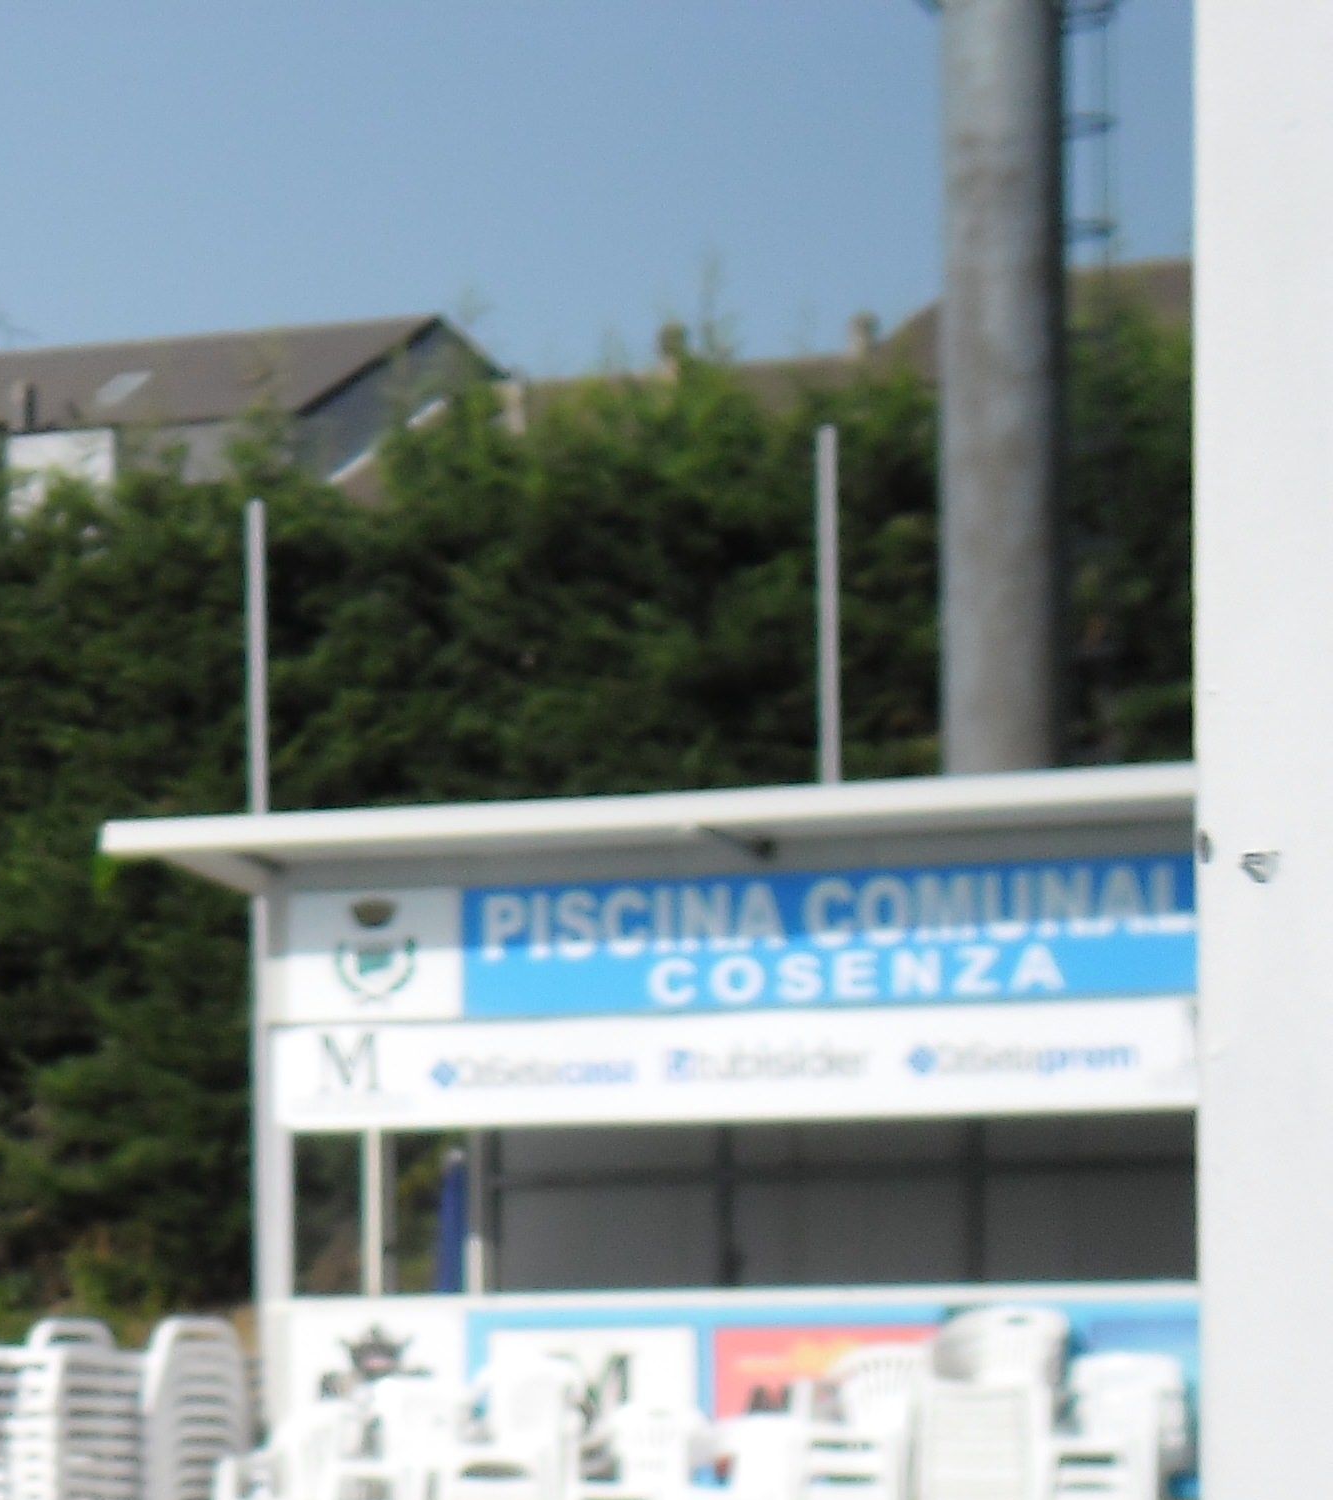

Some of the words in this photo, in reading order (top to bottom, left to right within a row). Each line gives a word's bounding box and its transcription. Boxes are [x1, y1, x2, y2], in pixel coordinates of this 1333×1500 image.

[483, 883, 789, 961] PISCINA
[803, 862, 1196, 950] COMUNAL
[645, 943, 1068, 1005] COSENZA
